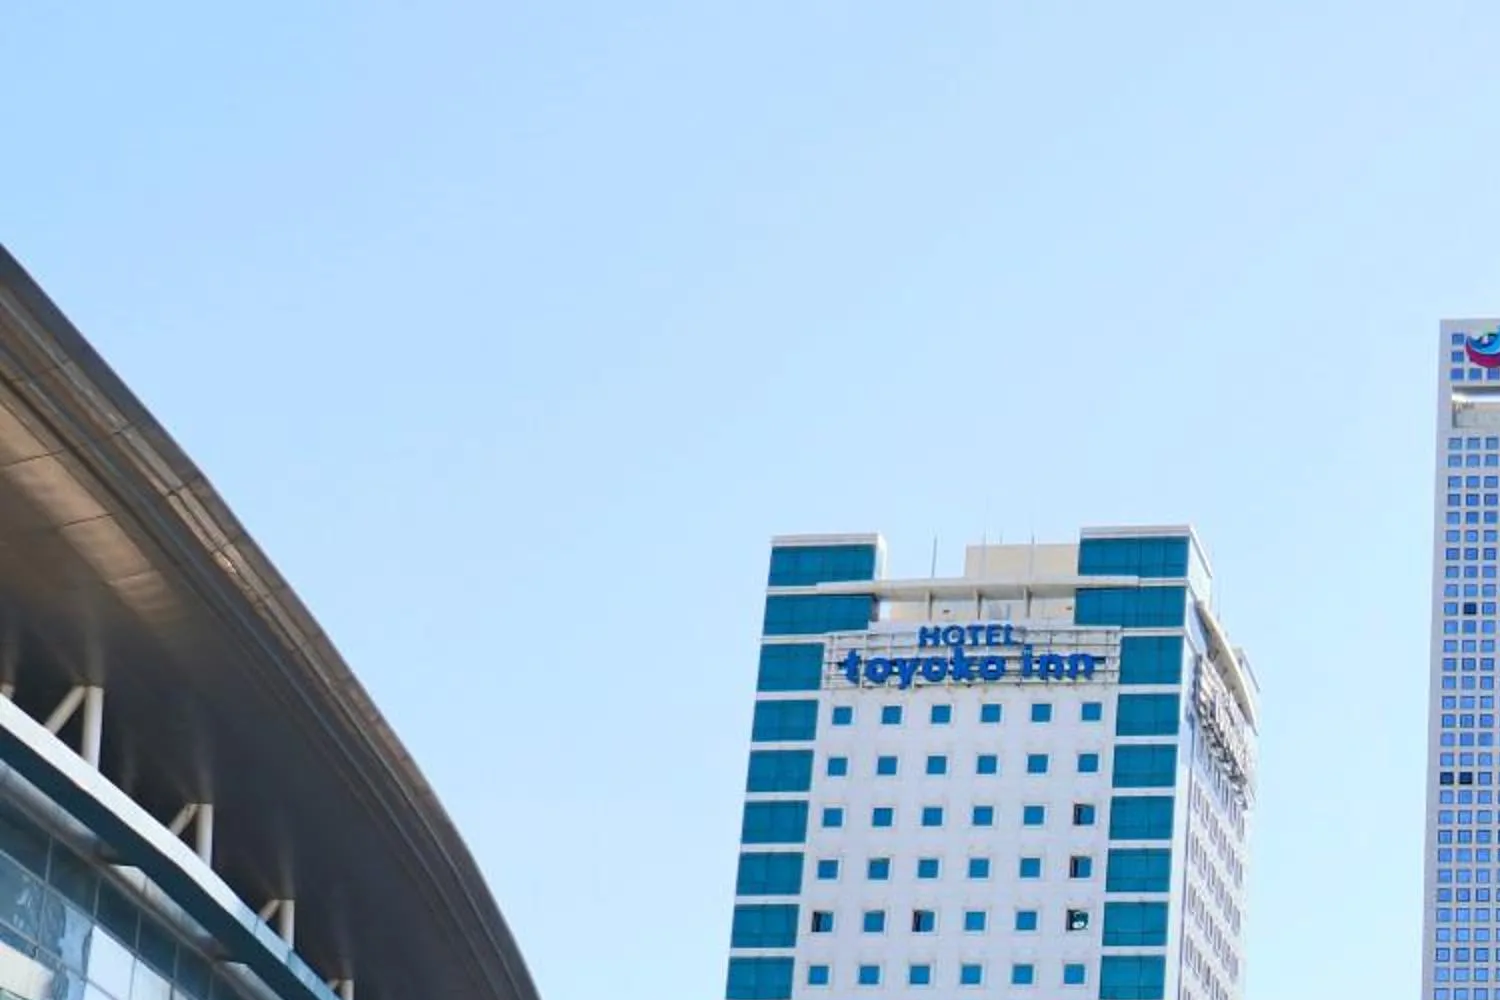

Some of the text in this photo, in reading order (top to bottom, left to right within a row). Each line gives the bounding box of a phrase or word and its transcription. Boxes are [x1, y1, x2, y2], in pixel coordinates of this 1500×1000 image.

[918, 623, 1020, 647] HOTEL
[843, 644, 1096, 690] toyoko inn
